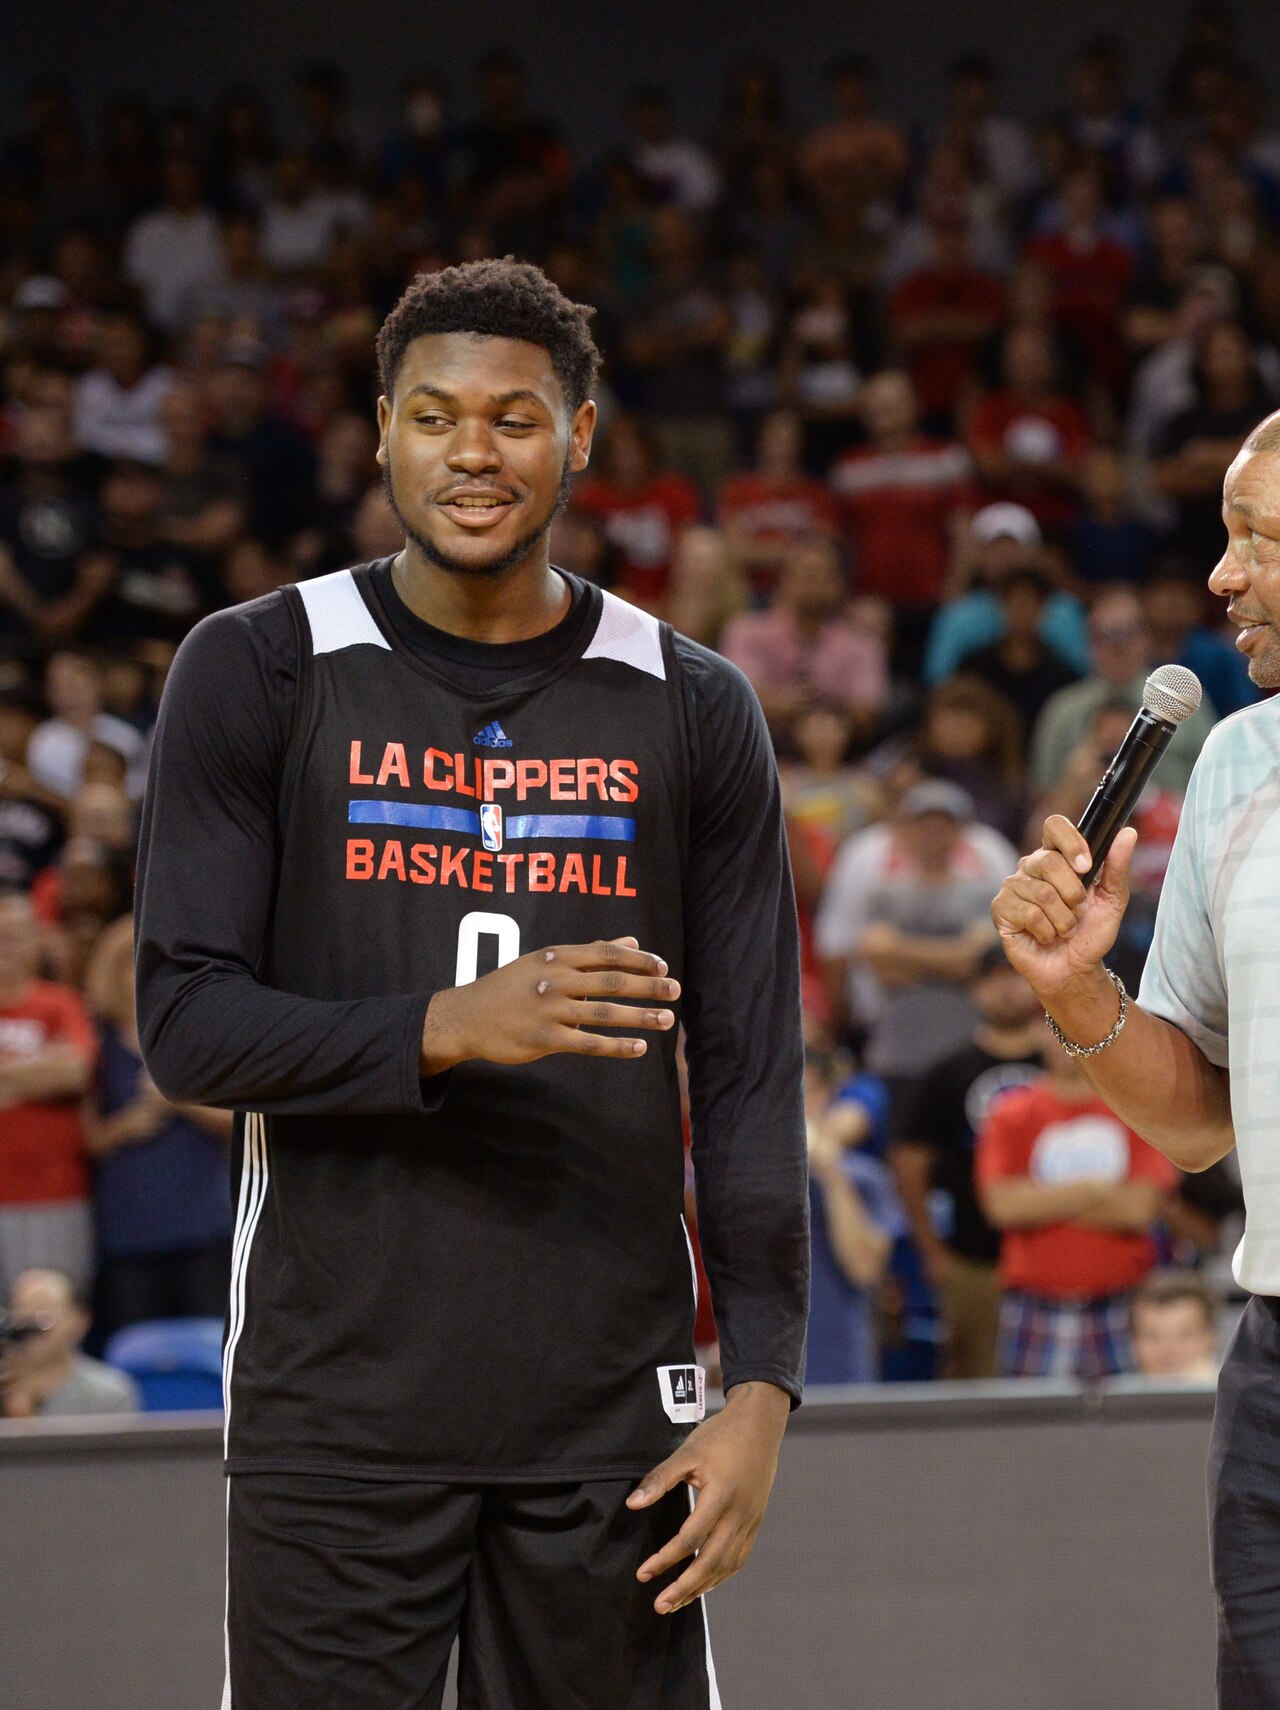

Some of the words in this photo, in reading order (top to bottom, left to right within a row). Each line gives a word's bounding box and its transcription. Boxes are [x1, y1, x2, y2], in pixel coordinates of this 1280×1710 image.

[473, 736, 513, 748] adidas
[350, 740, 410, 787] LA
[423, 747, 639, 803] CLIPPERS
[346, 839, 637, 897] BASKETBALL
